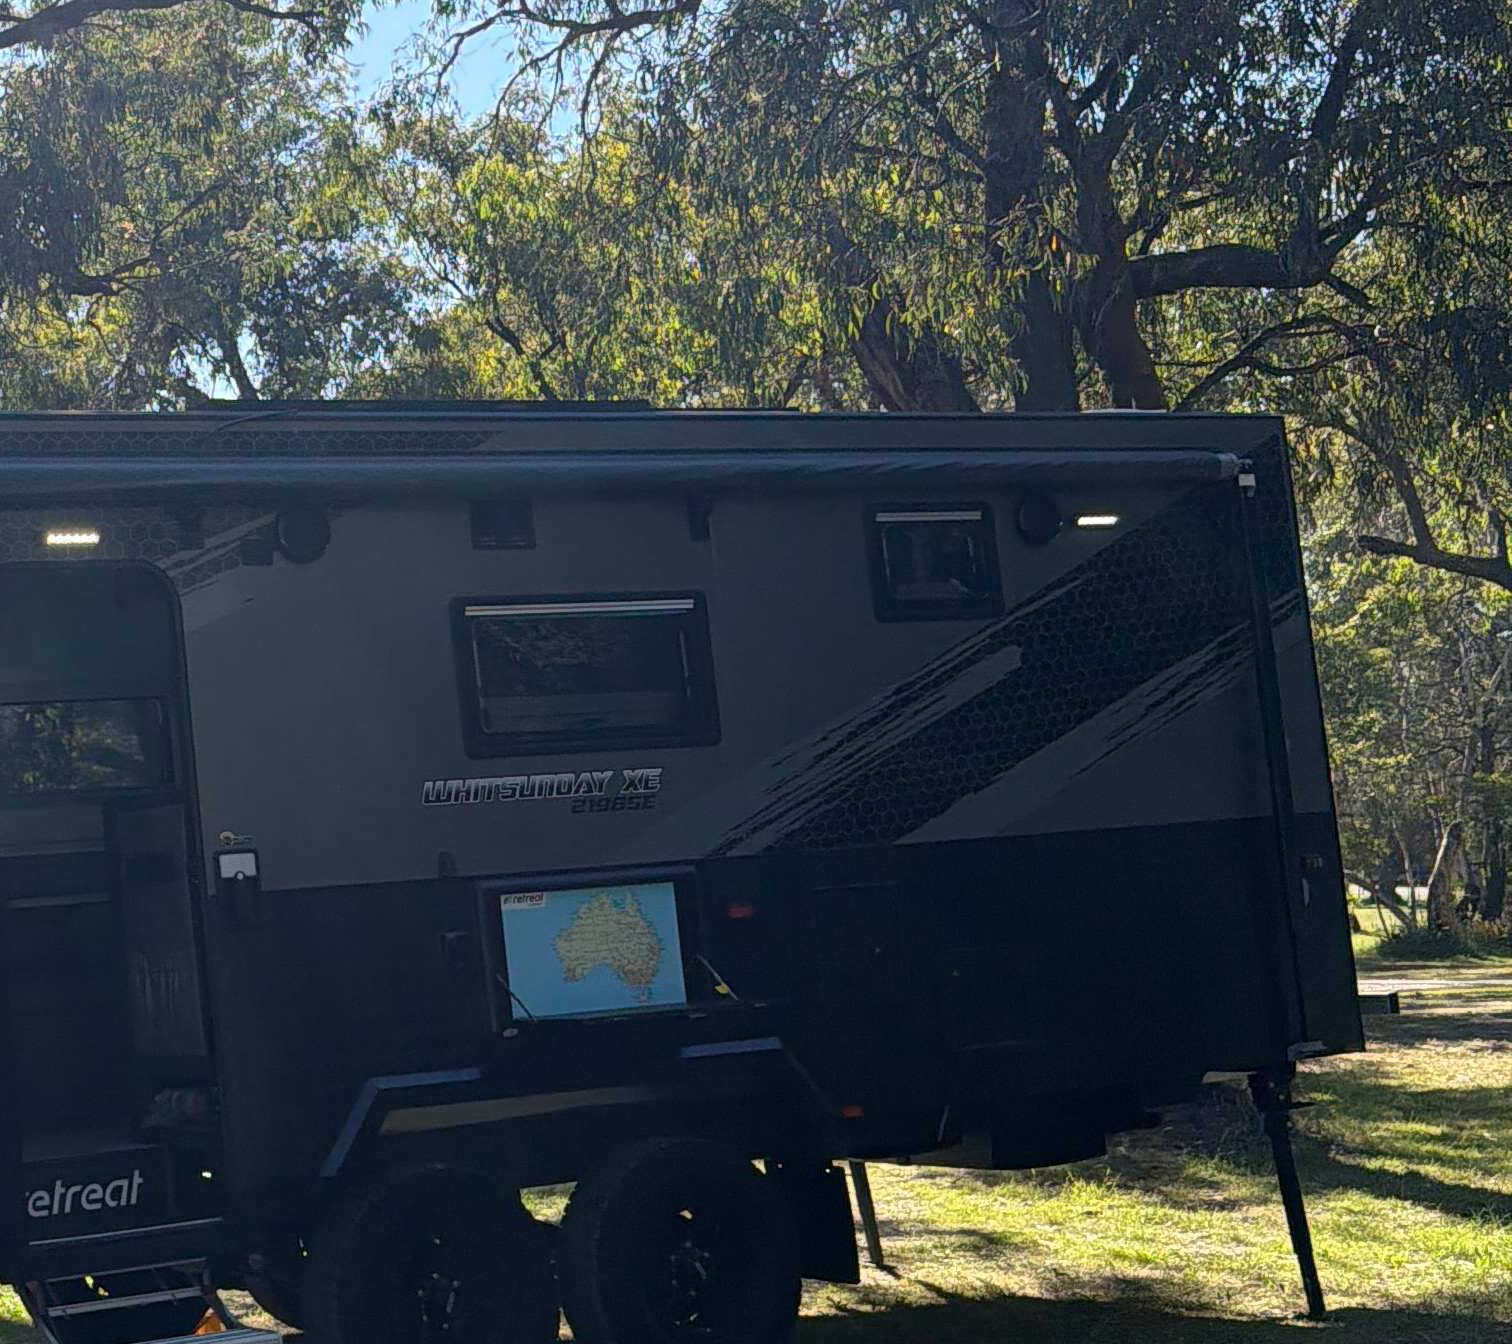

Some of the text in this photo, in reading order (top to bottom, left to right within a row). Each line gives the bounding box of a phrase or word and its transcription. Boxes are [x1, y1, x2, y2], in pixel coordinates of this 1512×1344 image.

[423, 767, 662, 805] WHITSUNDAY XE
[513, 891, 544, 904] retreat
[25, 1169, 144, 1218] etreat
